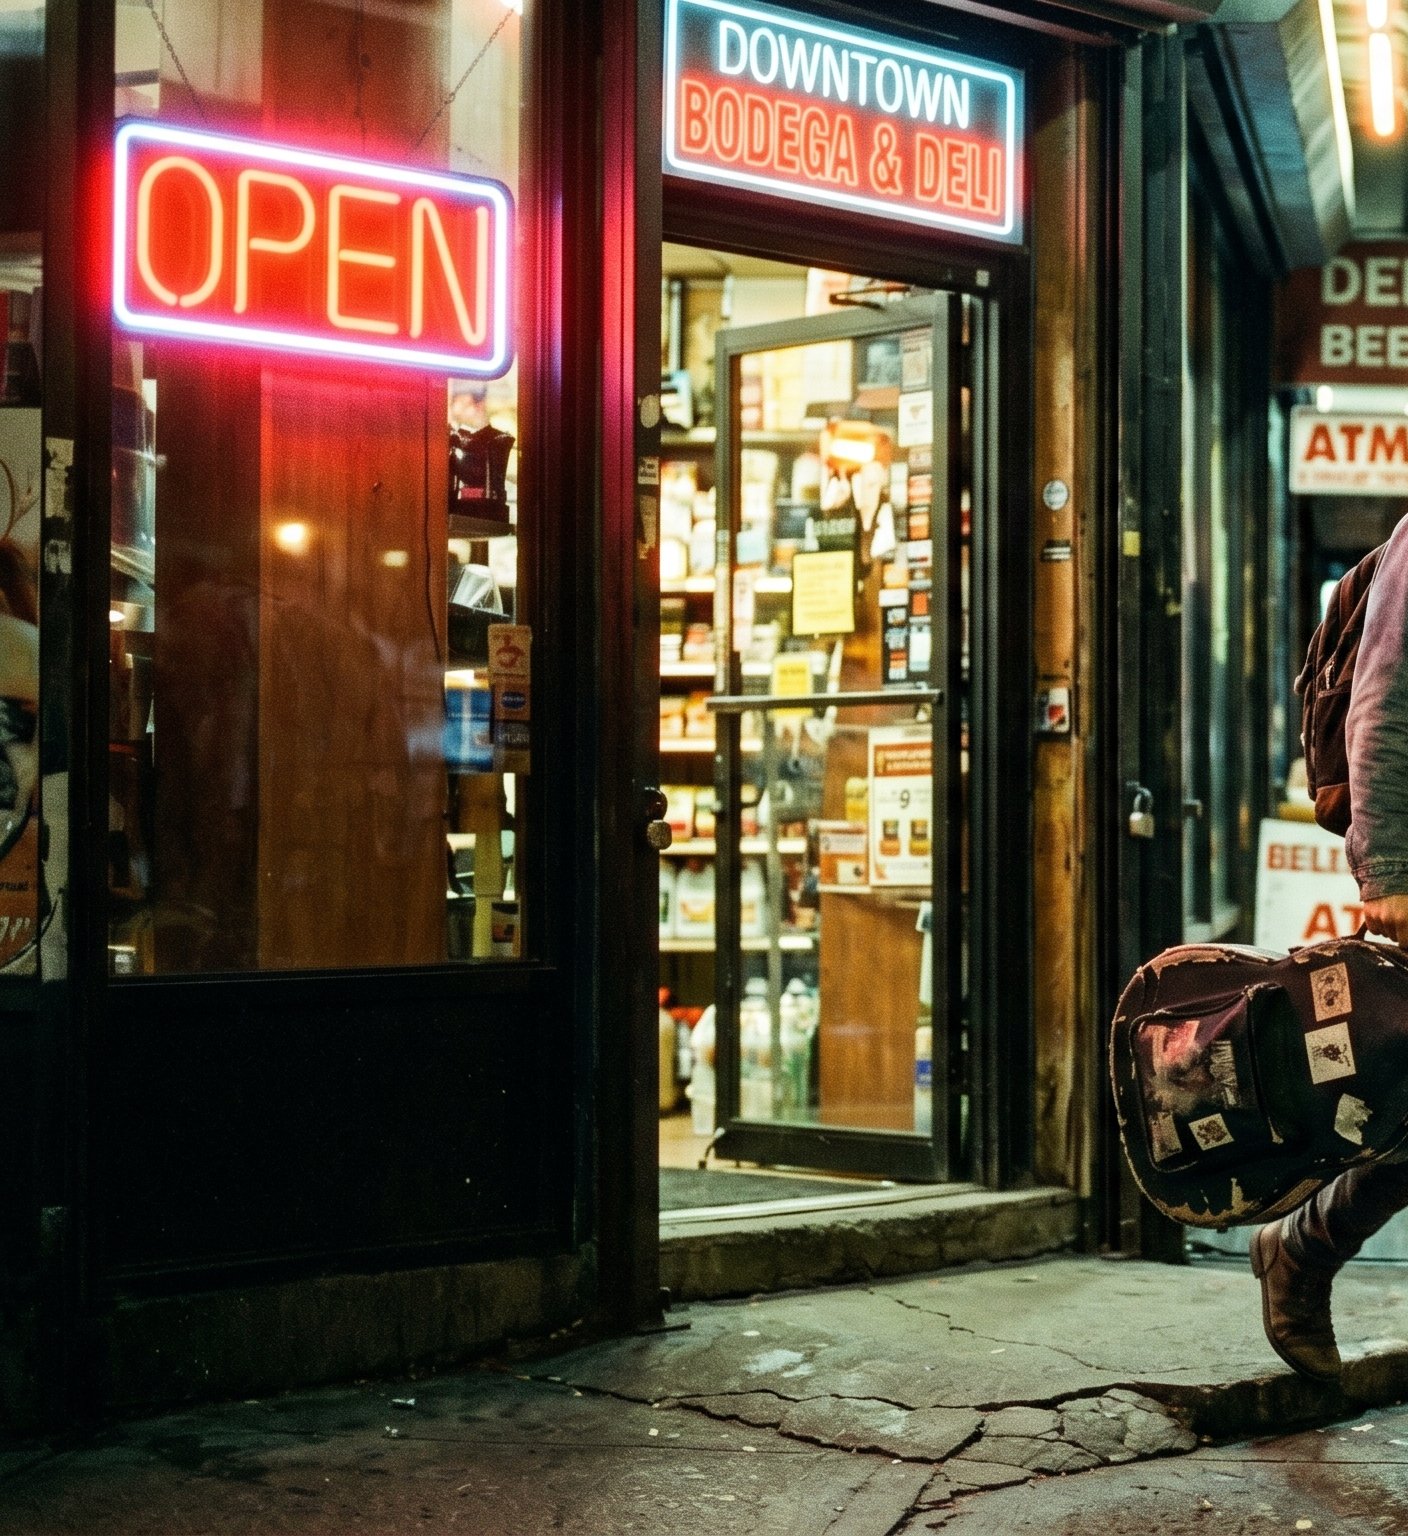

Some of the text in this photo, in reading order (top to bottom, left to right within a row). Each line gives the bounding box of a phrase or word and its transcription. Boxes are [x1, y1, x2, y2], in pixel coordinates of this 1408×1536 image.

[718, 19, 970, 129] DOWNTOWN
[681, 78, 1003, 217] BODEGA & DELI
[136, 155, 489, 347] OPEN
